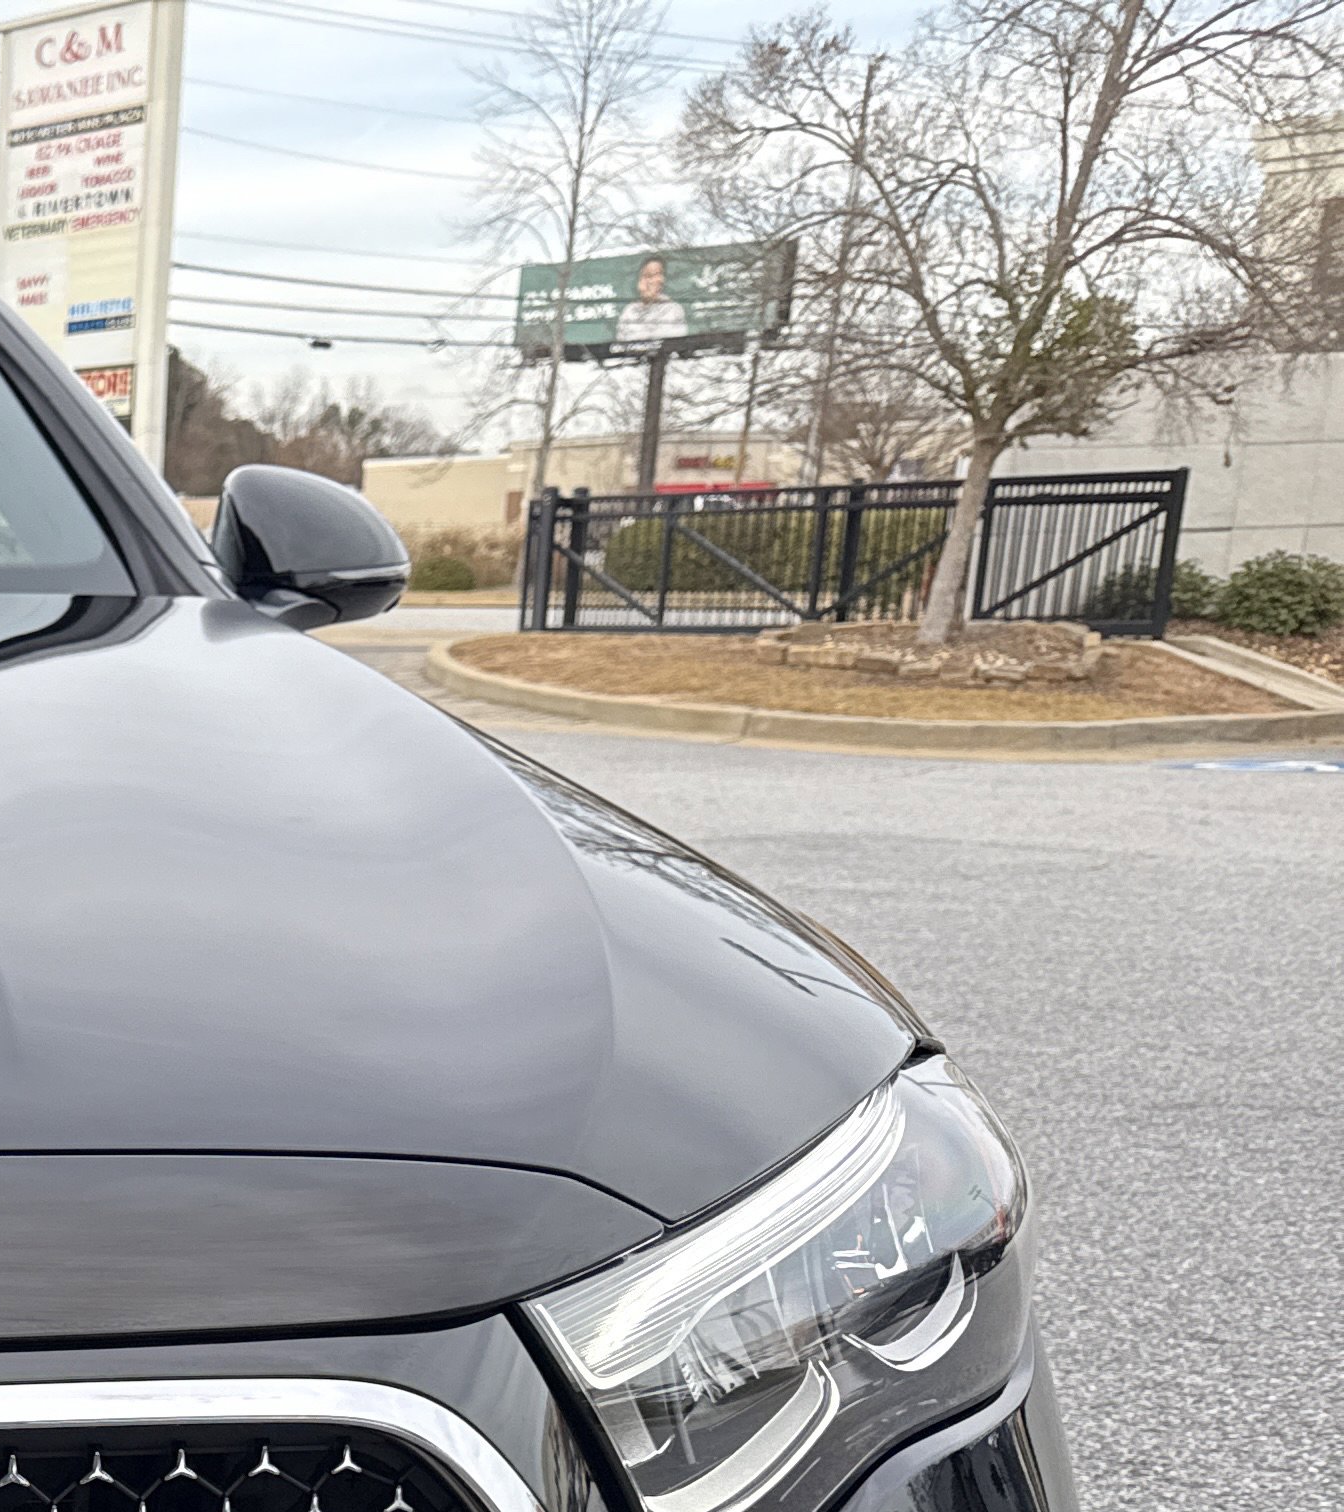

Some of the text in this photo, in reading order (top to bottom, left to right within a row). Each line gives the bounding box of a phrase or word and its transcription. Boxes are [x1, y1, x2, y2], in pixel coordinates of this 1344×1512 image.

[81, 168, 135, 187] TOBACCO
[32, 187, 134, 217] RIVERTOWN
[70, 207, 142, 233] EMERGENCY
